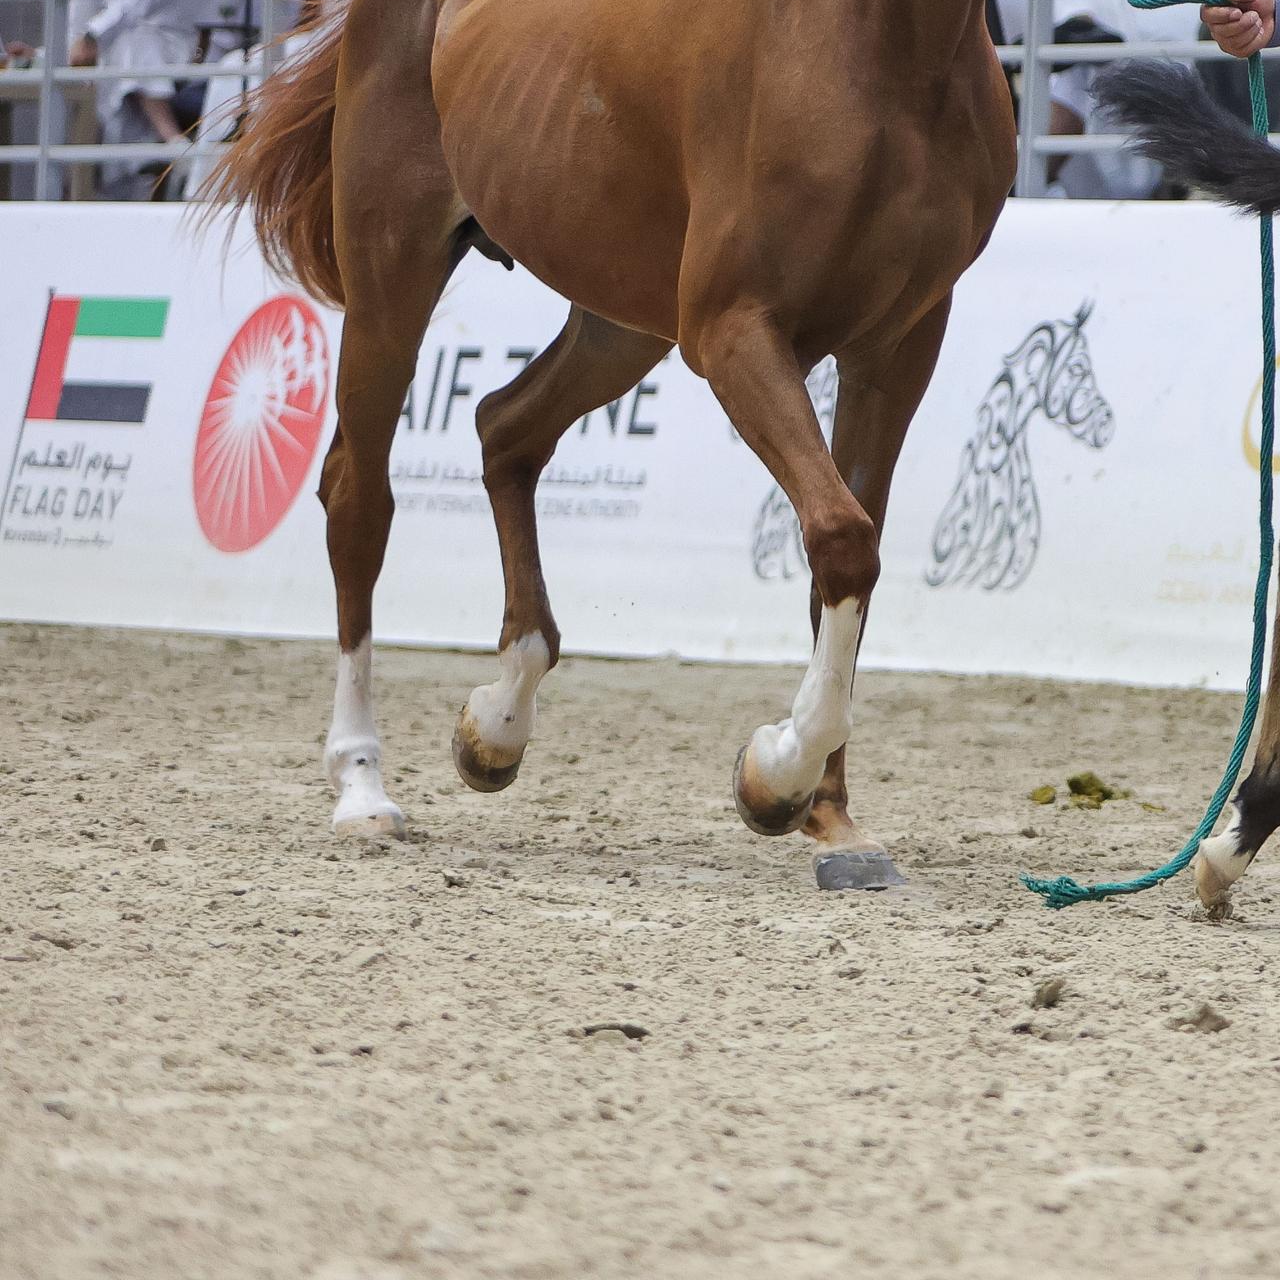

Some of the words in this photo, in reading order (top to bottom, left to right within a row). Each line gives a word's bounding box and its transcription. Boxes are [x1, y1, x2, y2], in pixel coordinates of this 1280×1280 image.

[19, 441, 85, 475] العلم
[86, 452, 133, 482] يوم
[8, 485, 67, 517] FLAG
[74, 487, 125, 521] DAY
